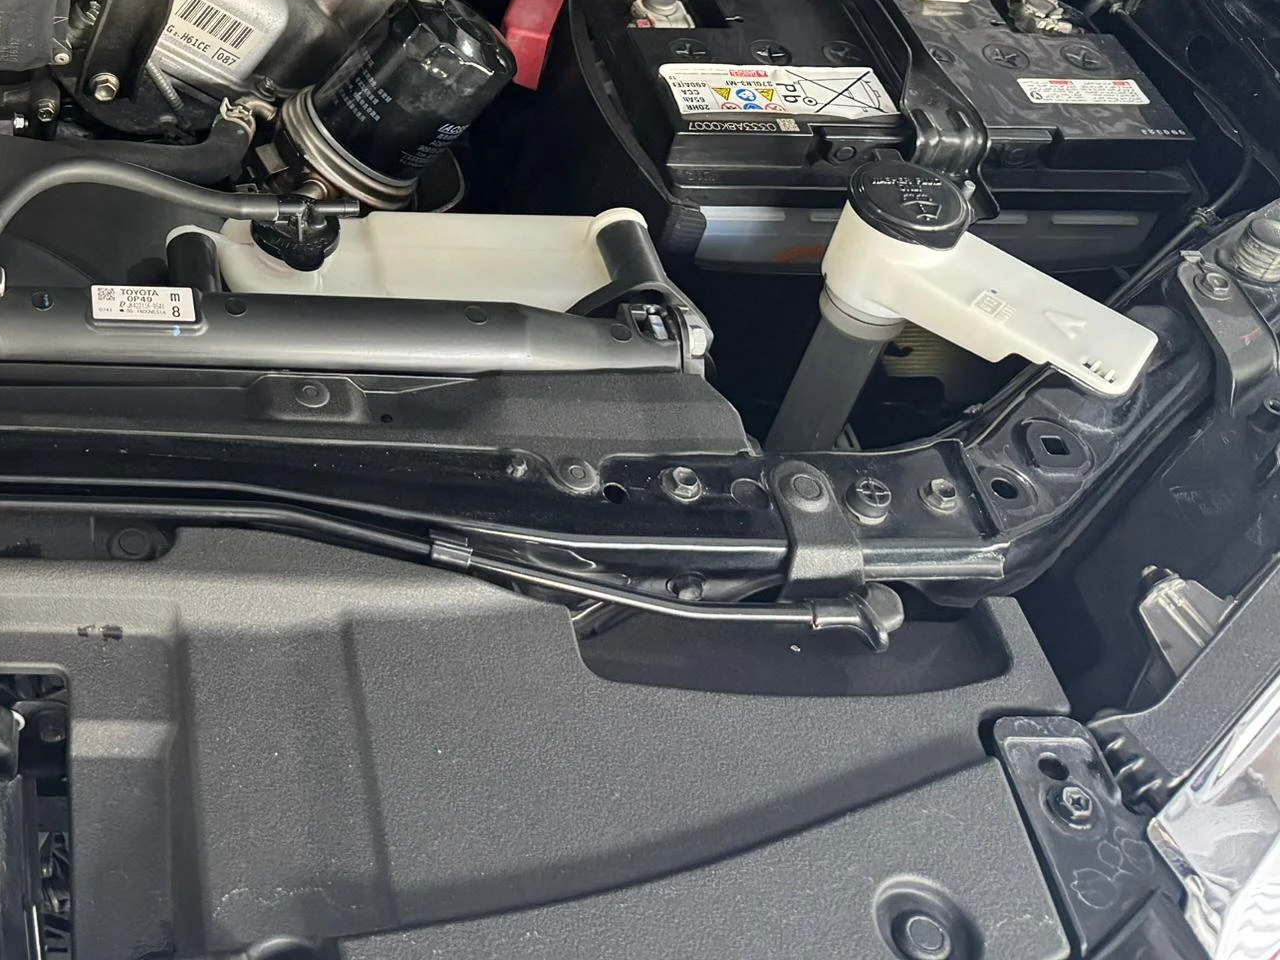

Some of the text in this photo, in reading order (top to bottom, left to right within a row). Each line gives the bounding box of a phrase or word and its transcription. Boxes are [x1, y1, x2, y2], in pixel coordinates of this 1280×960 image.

[216, 52, 237, 66] 087
[120, 288, 160, 297] TOYOTA
[171, 305, 181, 318] 8
